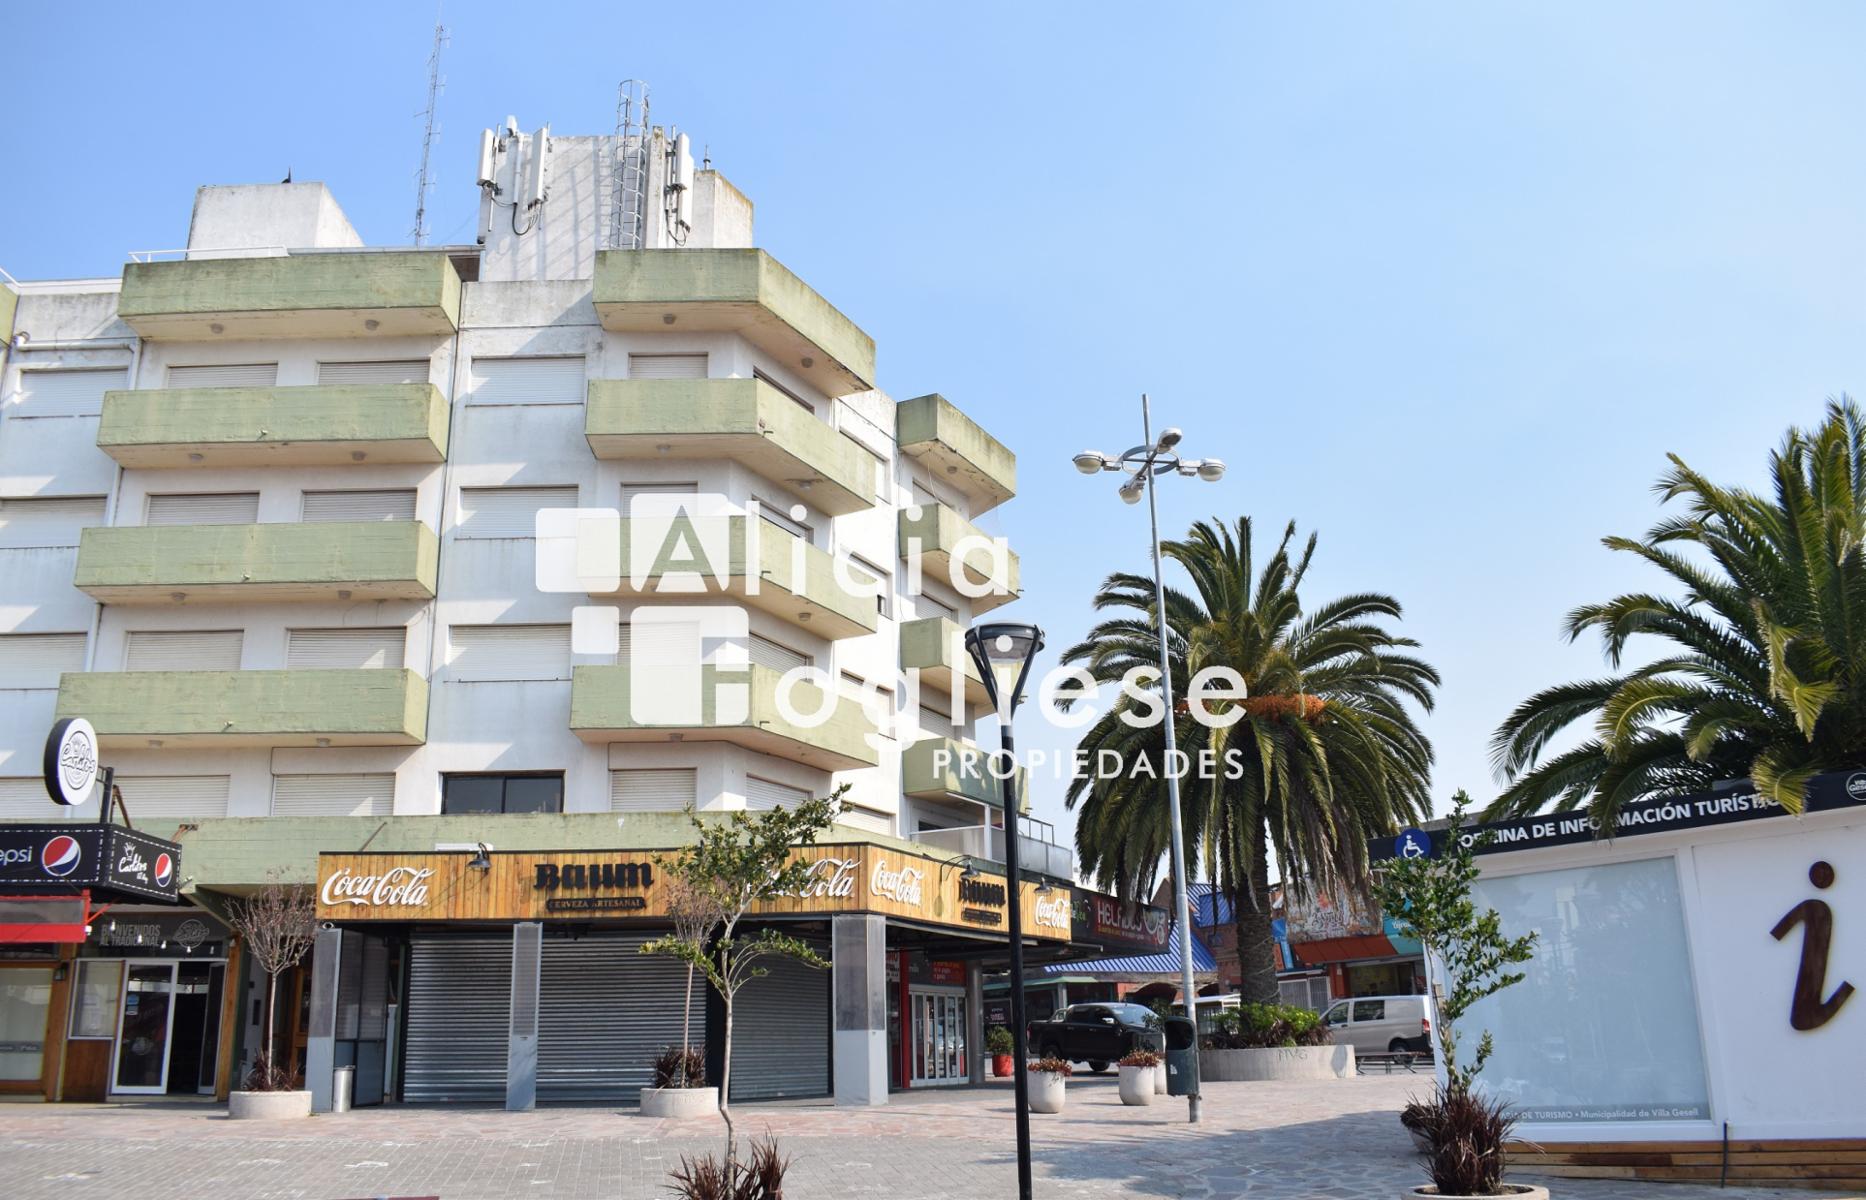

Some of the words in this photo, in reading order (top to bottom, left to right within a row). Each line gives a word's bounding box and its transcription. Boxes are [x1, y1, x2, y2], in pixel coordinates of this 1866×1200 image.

[1460, 827, 1530, 848] OFINA
[1532, 822, 1557, 839] DE
[1559, 801, 1692, 835] INFOMACIÓN
[1694, 792, 1780, 816] TURÍST
[321, 866, 437, 906] Coca-Cola
[870, 859, 924, 906] Coca-Cola
[112, 936, 160, 946] TRADICONAL
[1535, 1111, 1573, 1119] TURISMO
[1580, 1109, 1636, 1119] Municipalidad
[1639, 1109, 1649, 1117] de
[1651, 1108, 1670, 1117] Villa
[1671, 1108, 1699, 1117] Gesell
